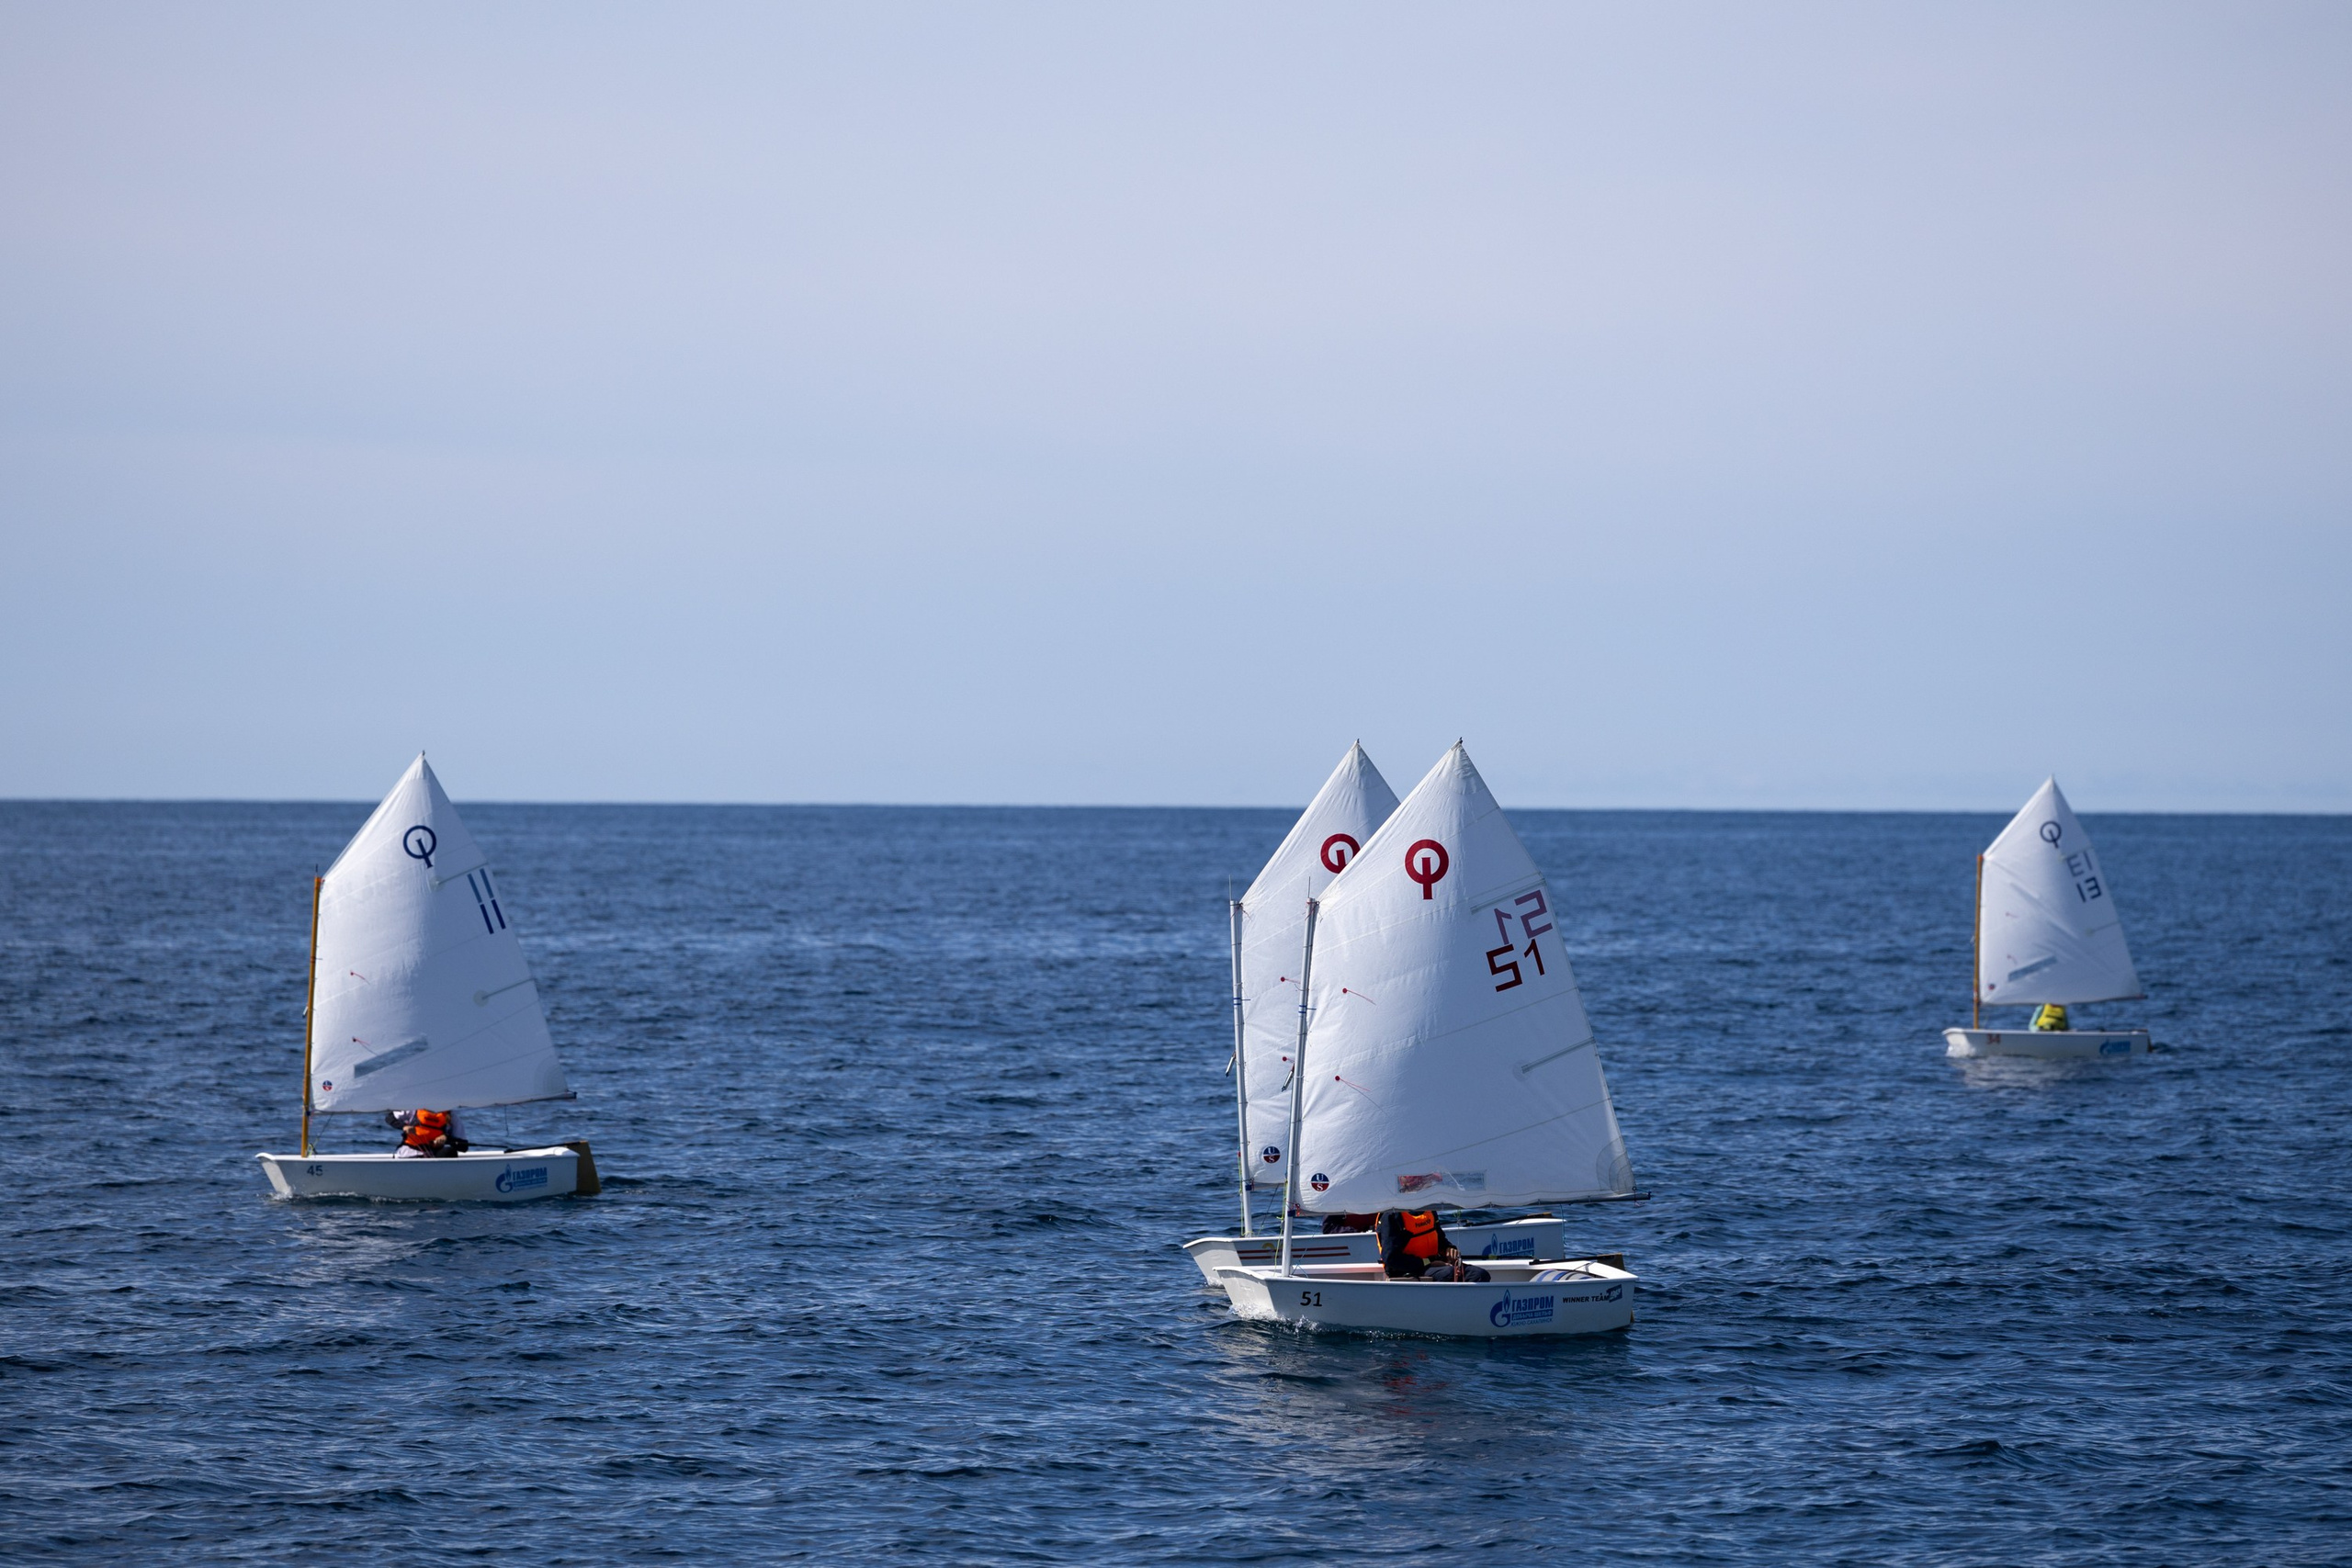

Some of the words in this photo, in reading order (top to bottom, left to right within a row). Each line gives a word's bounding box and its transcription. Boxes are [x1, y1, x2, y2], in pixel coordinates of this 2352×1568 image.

[2076, 876, 2102, 903] 13
[480, 898, 506, 934] 11
[1486, 939, 1544, 992] 51
[306, 1165, 323, 1177] 45
[1499, 1237, 1534, 1254] ГАЗПРОМ
[1300, 1291, 1323, 1307] 51
[1511, 1295, 1555, 1312] ГАЗПРОМ
